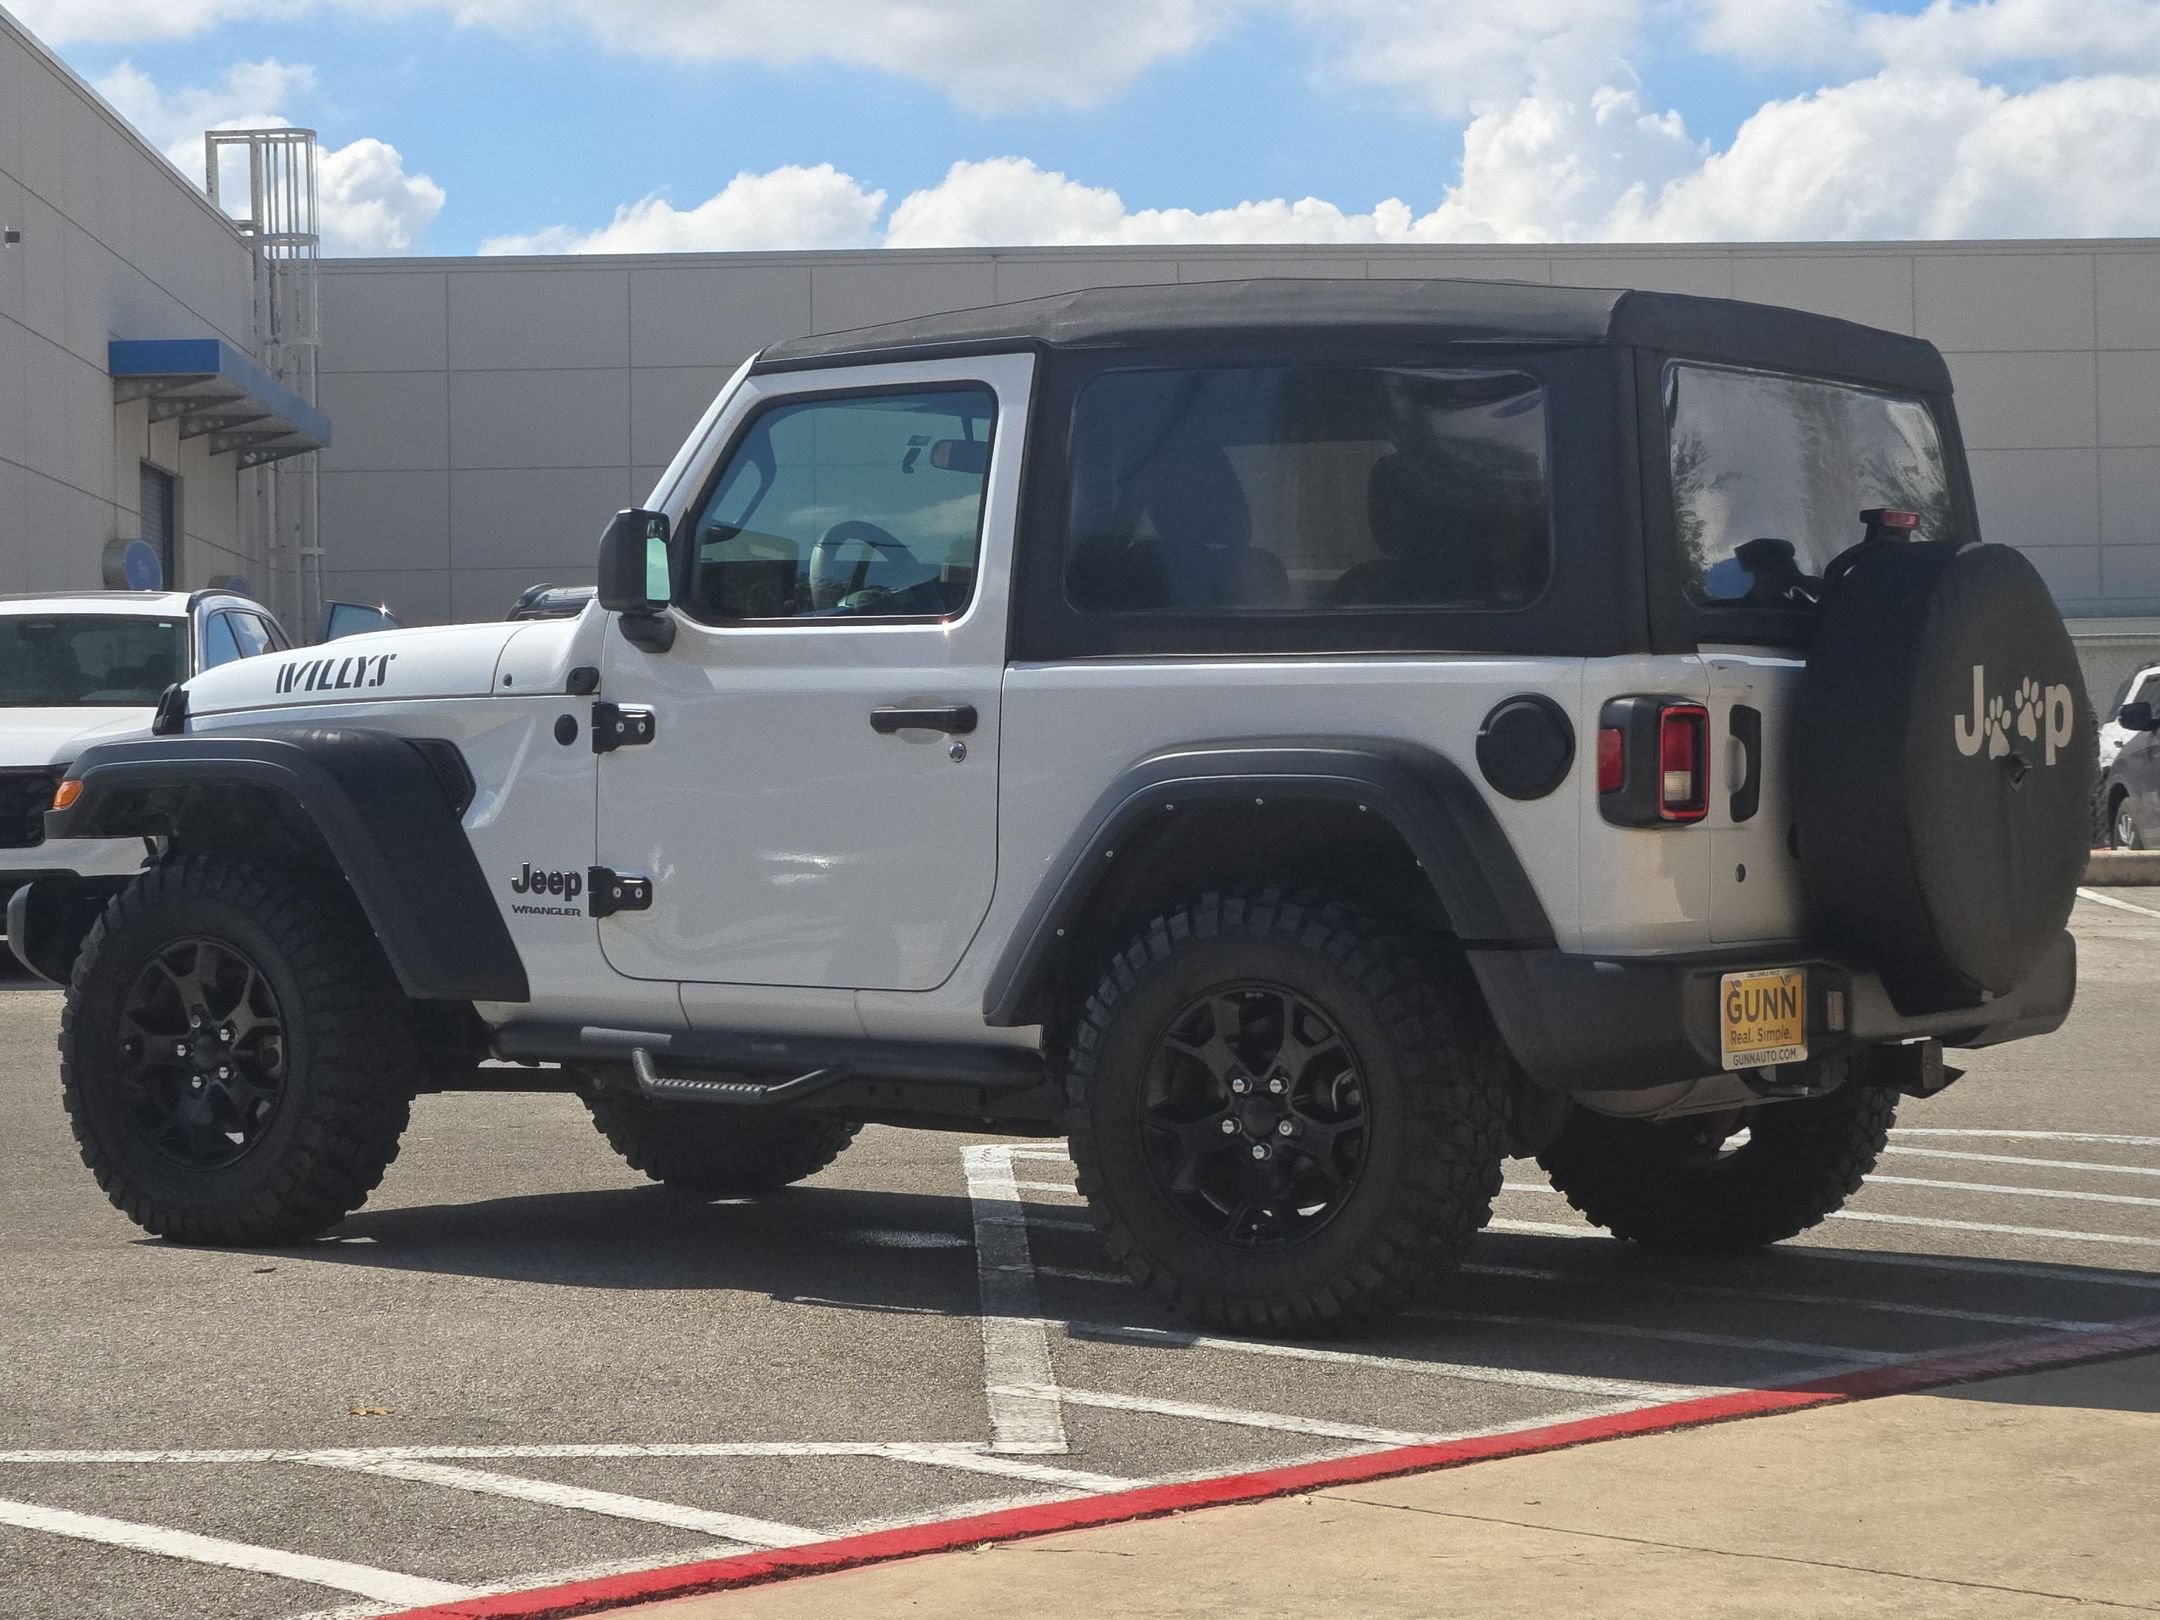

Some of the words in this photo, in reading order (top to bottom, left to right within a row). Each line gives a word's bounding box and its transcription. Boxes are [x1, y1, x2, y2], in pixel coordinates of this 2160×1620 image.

[276, 654, 397, 694] WILLYS
[511, 861, 582, 901] Jeep
[512, 905, 581, 917] WRANGLER
[1726, 986, 1796, 1024] GUNN
[1730, 1028, 1754, 1045] Real.
[1757, 1024, 1792, 1044] Simple.
[1733, 1048, 1797, 1066] GUNNAUTO.COM
